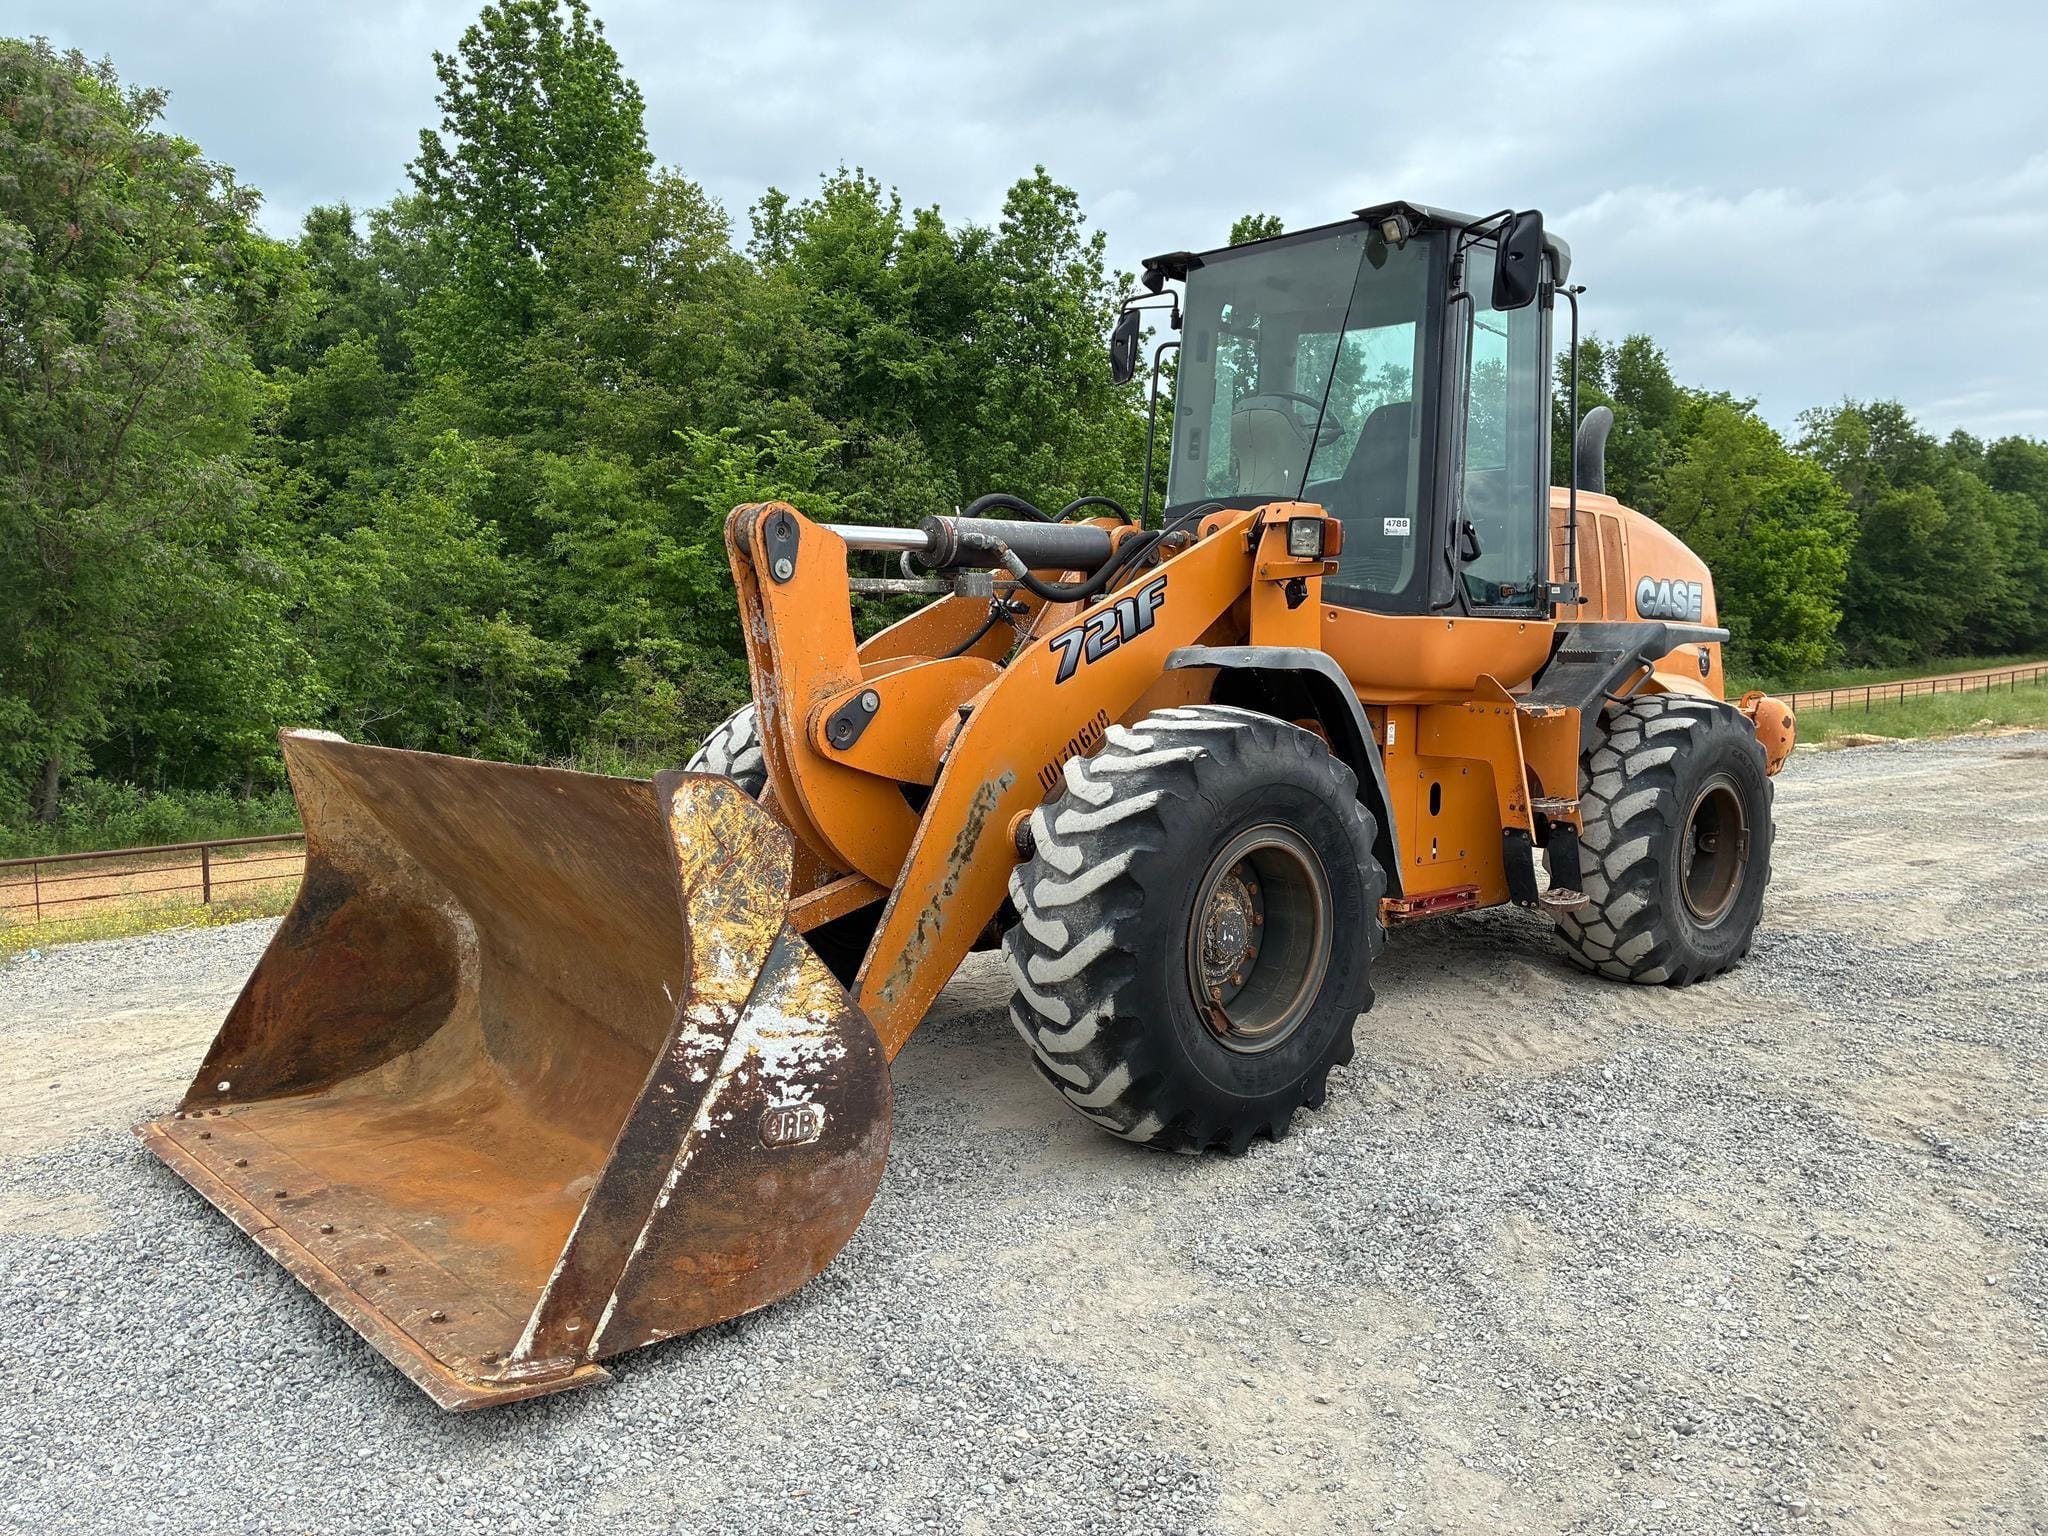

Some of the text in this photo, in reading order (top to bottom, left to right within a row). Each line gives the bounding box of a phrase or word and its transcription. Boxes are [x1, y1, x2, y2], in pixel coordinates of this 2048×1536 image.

[1386, 519, 1408, 528] 4788
[1636, 576, 1702, 622] CASE
[1050, 574, 1167, 684] 721F
